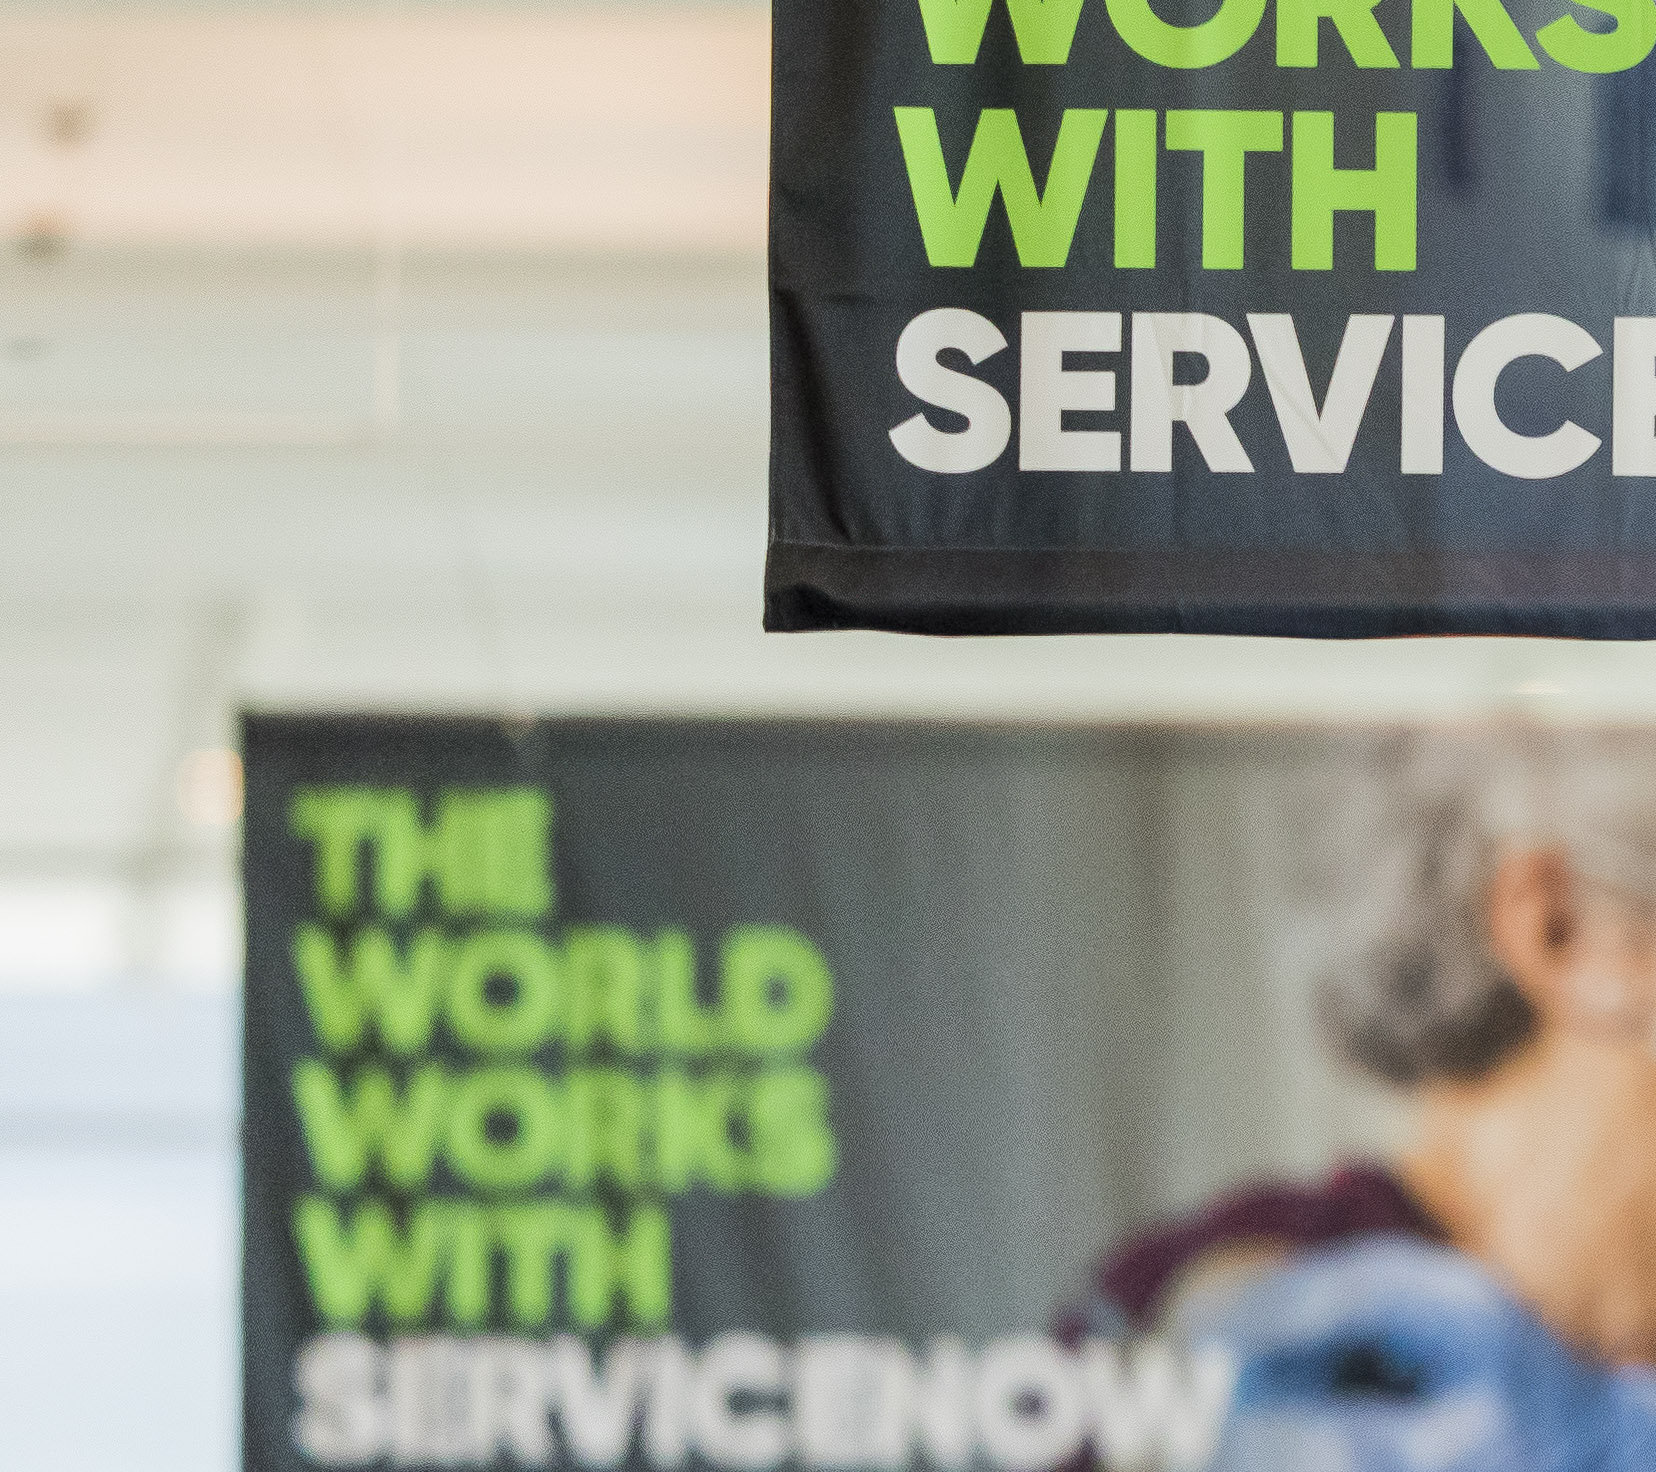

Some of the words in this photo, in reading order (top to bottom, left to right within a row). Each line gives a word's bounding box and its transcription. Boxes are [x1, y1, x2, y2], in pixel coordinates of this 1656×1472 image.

[893, 107, 1419, 272] WITH
[295, 787, 554, 918] THE
[296, 924, 834, 1056] WORLD
[296, 1061, 836, 1194] WORKS
[296, 1196, 670, 1326] WITH
[296, 1331, 1234, 1470] SERVICENOW
